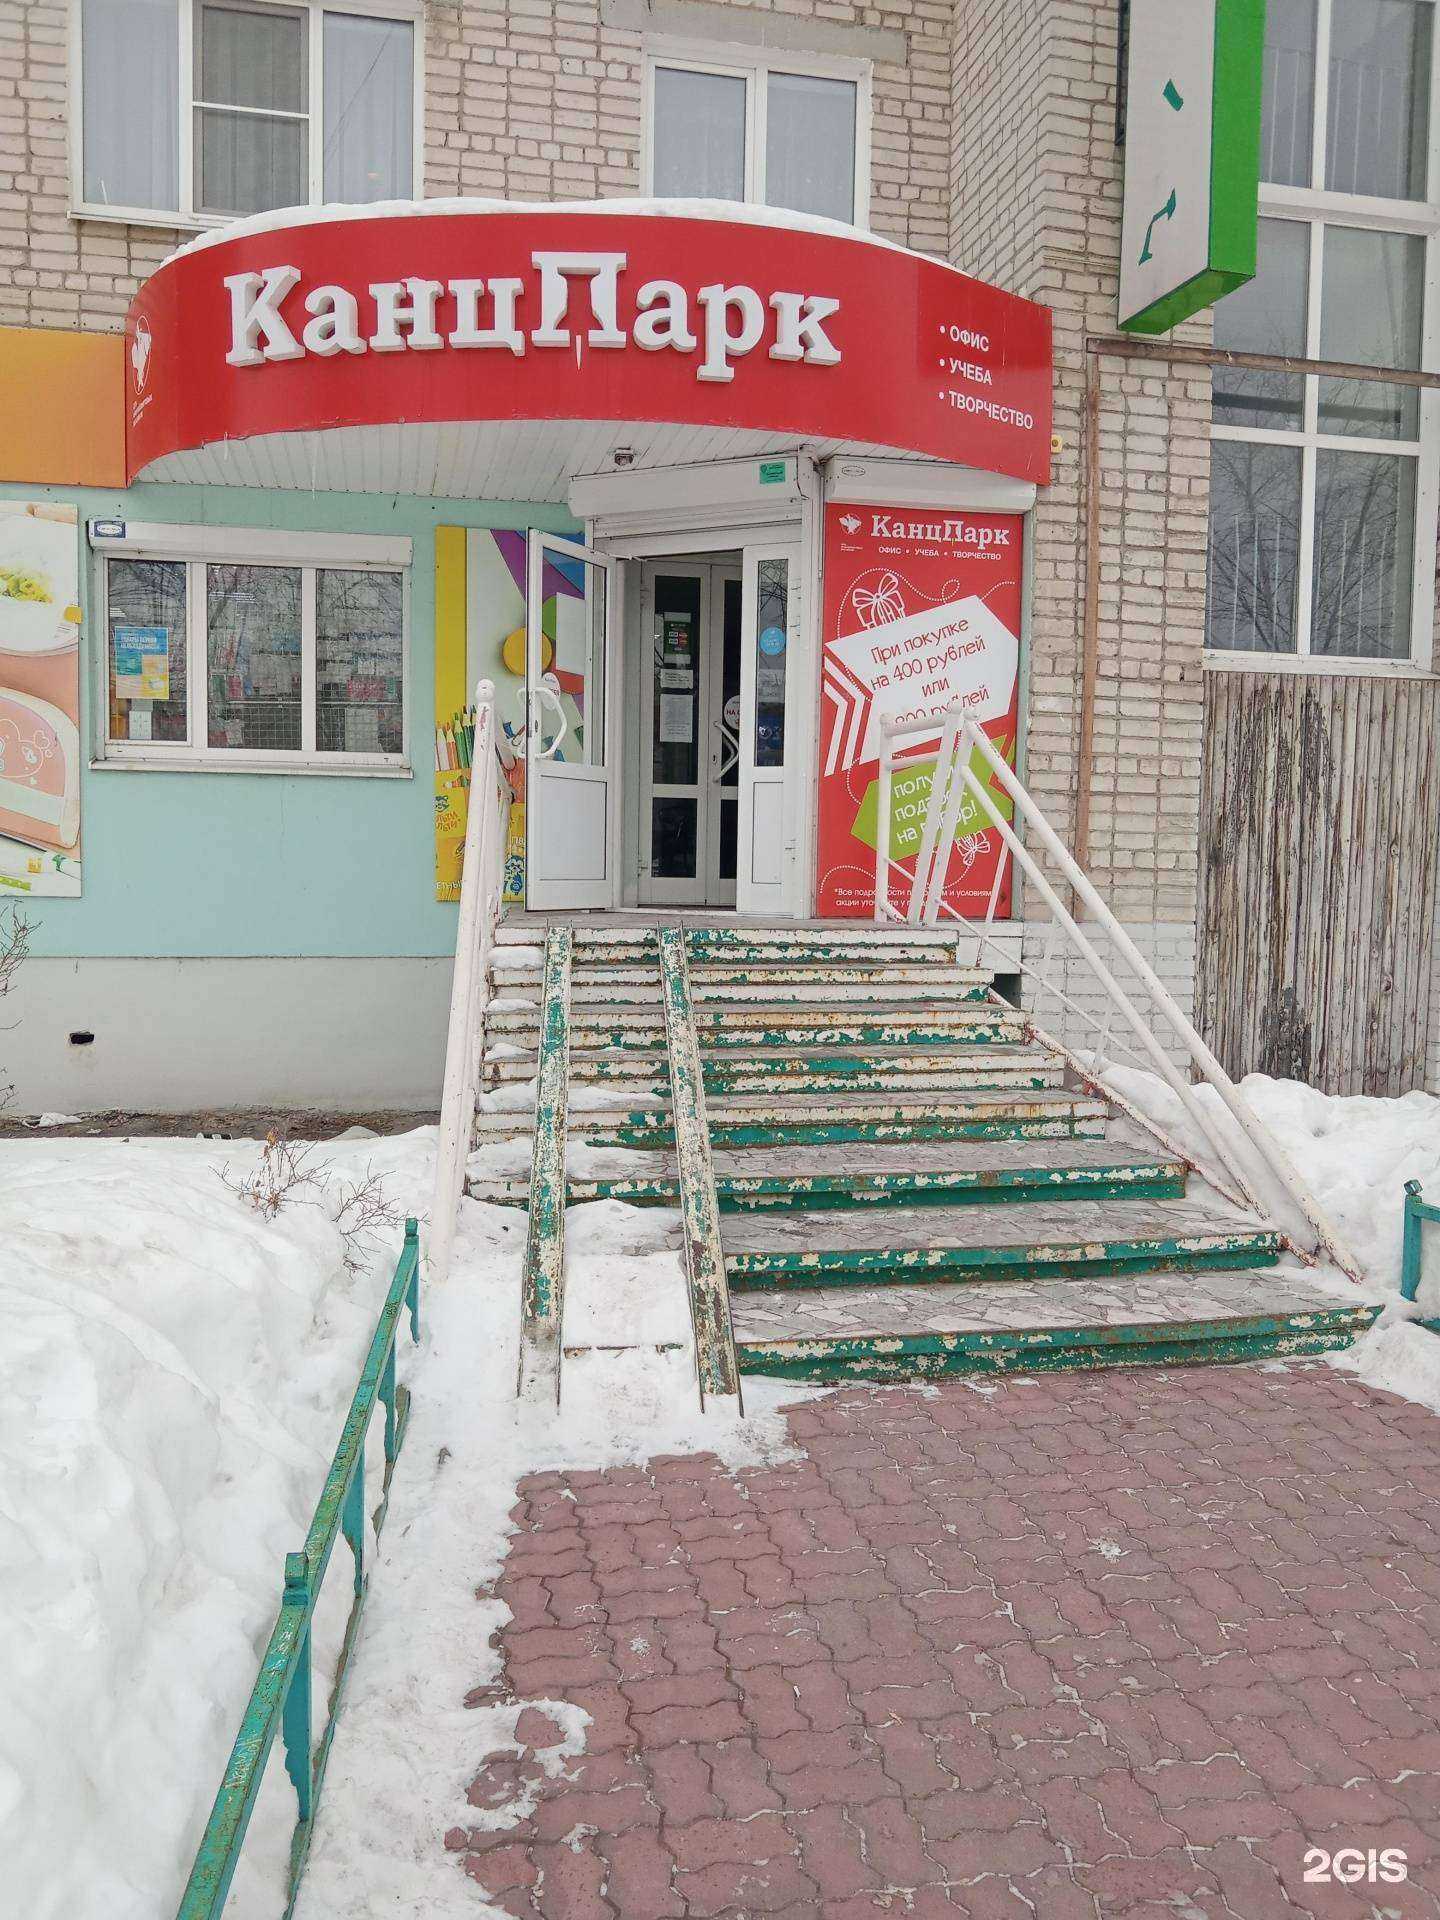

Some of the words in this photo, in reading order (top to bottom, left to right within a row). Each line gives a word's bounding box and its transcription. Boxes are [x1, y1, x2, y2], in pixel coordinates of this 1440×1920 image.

[223, 251, 841, 383] КанцПарк
[949, 325, 990, 352] ОФИС
[949, 357, 993, 386] УЧЕБА
[948, 390, 1034, 430] ТВОРЧЕСТВО
[871, 514, 1010, 550] КанцПарк
[878, 546, 902, 554] ОФИС
[914, 548, 940, 557] УЧЕБА
[952, 550, 1002, 561] ТВОРЧЕСТВО
[870, 642, 902, 666] При
[903, 618, 970, 652] покупке
[870, 674, 890, 691] на
[893, 659, 923, 682] 400
[927, 635, 987, 673] рублей
[921, 678, 951, 698] или
[930, 684, 990, 716] рулей
[896, 827, 918, 845] на
[836, 899, 860, 907] акции
